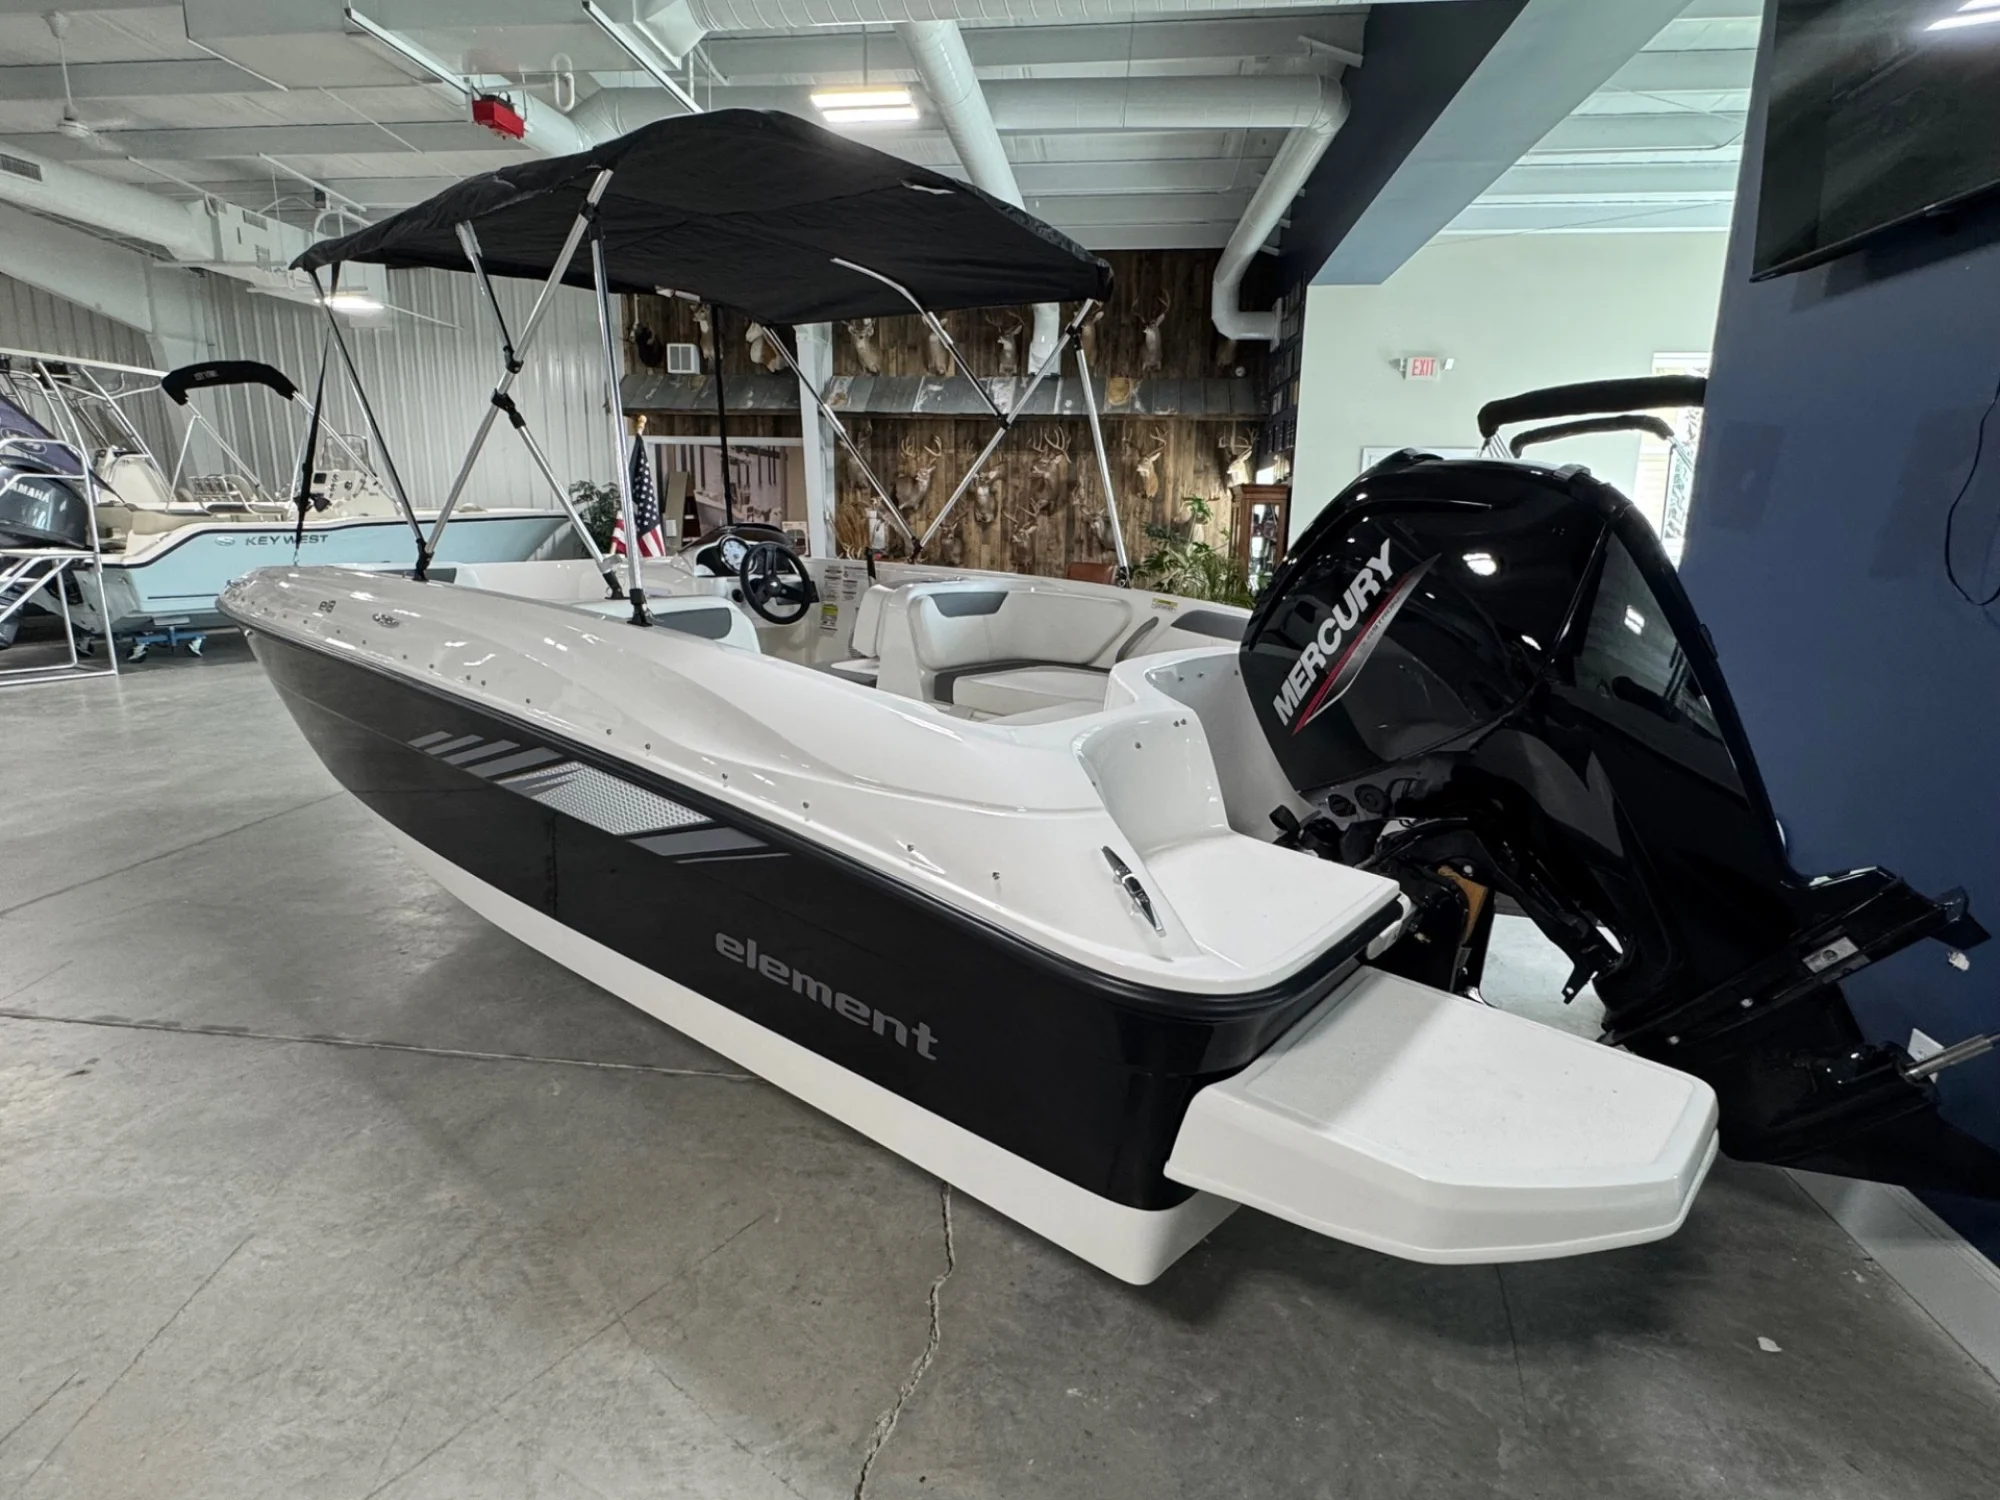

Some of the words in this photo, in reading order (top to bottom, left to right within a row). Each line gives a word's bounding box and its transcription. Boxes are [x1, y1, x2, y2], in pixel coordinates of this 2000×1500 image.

[1411, 358, 1436, 376] EXIT
[246, 535, 281, 546] KEY
[283, 534, 328, 545] WEST
[1272, 537, 1393, 726] MERCURY
[715, 932, 939, 1061] element
